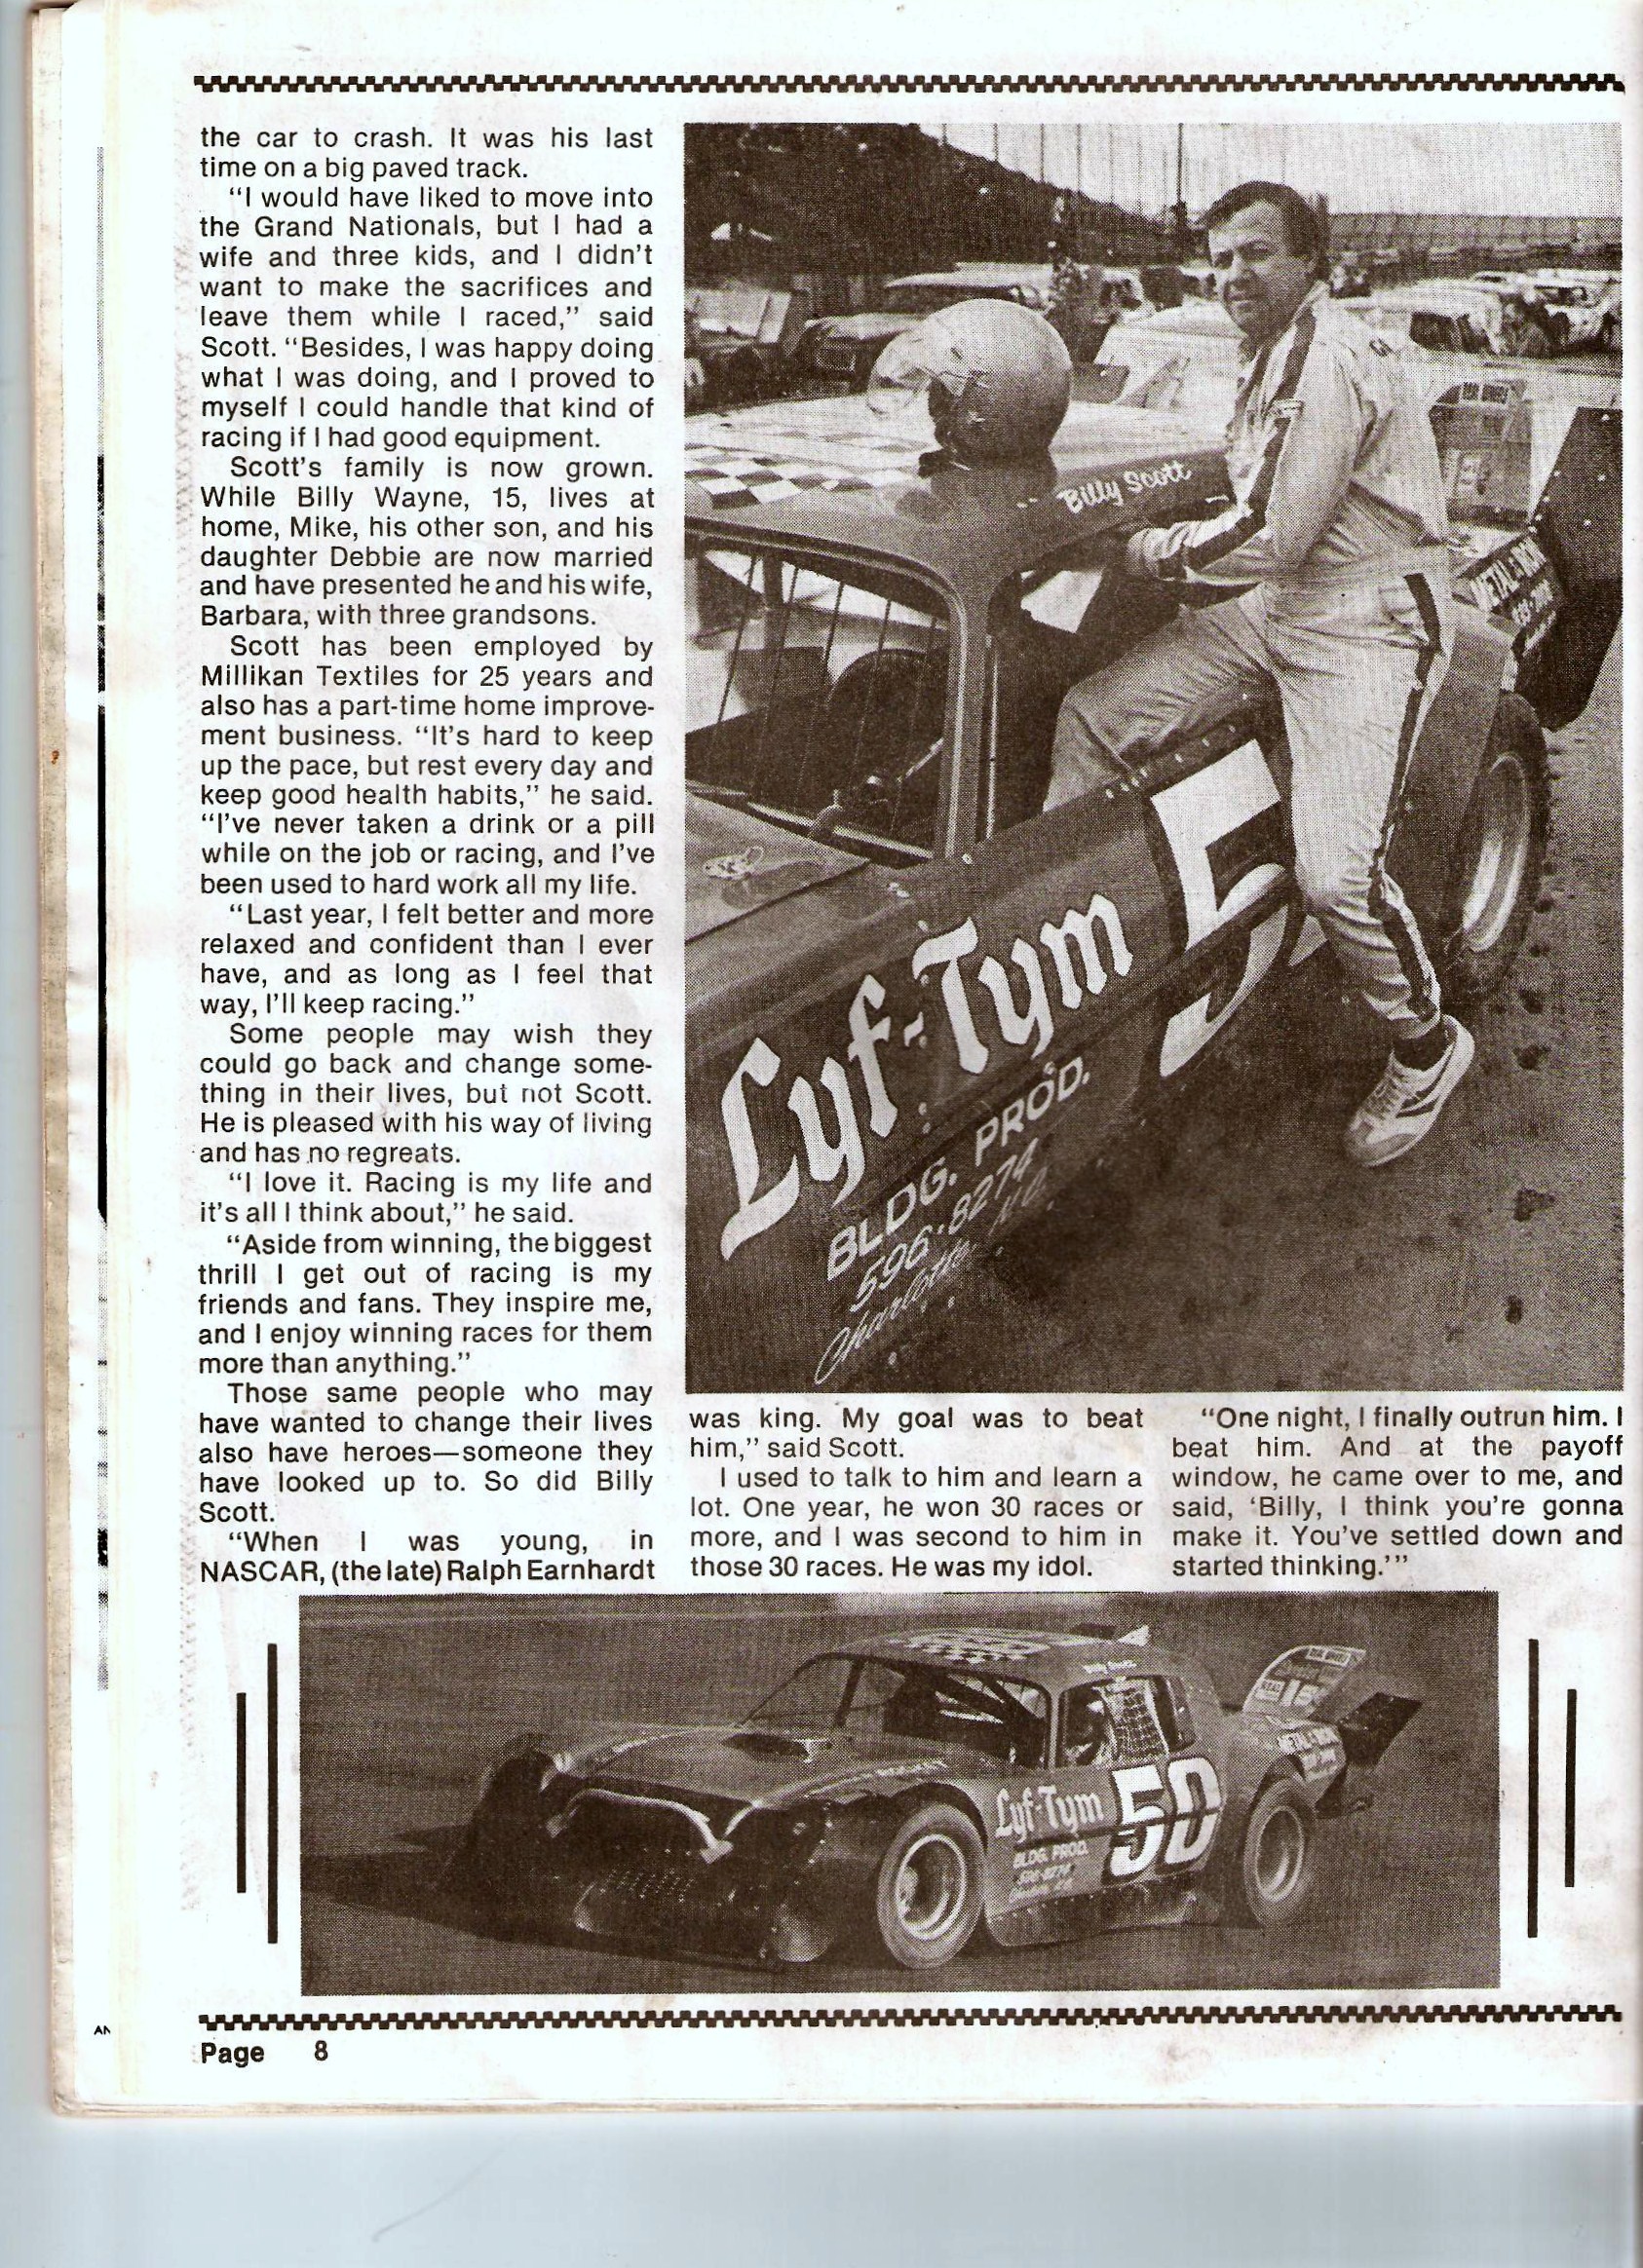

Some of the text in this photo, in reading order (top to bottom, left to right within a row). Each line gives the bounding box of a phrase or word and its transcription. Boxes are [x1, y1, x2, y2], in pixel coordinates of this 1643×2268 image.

[201, 127, 652, 148] the car to crash. It was his last
[200, 157, 527, 182] time on a big paved track.
[200, 276, 651, 297] want to make the sacrifices and
[201, 486, 654, 511] While Billy Wayne, 15, lives at
[1055, 460, 1192, 514] Billy Scott
[201, 546, 652, 571] daughter Debbie are now married
[202, 604, 595, 629] Barbara, with three grandsons.
[231, 635, 653, 662] Scott has been employed by
[203, 664, 652, 691] Millikan Textiles for 25 years and
[202, 695, 654, 721] also has a part-time home improve-
[276, 817, 344, 834] never
[358, 813, 428, 834] taken
[442, 818, 456, 834] a
[470, 813, 534, 834] drink
[549, 818, 574, 833] or
[588, 818, 601, 834] a
[617, 813, 654, 839] pill
[201, 1052, 652, 1078] could go back and change some-
[720, 893, 1133, 1261] Lyf-Tym
[201, 1082, 651, 1108] thing in their lives, but not Scott.
[202, 1112, 651, 1138] He is pleased with his way of living
[827, 1056, 1089, 1282] BLDG. PROD.
[199, 1292, 651, 1317] friends and fans. They inspire me,
[227, 1381, 652, 1407] Those same people who may
[689, 1407, 1143, 1433] was king. My goal was to beat
[1173, 1435, 1623, 1460] beat him. And at the payoff
[201, 1470, 653, 1495] have looked up to. So did Billy
[1172, 1465, 1623, 1491] window, he came over to me, and
[200, 1502, 274, 1523] Scott.
[692, 1496, 1143, 1522] lot. One year, he won 30 races or
[202, 1559, 655, 1586] NASCAR, (the late) Ralph Earnhardt
[1110, 1758, 1221, 1877] 50
[201, 2040, 328, 2067] Page 8
